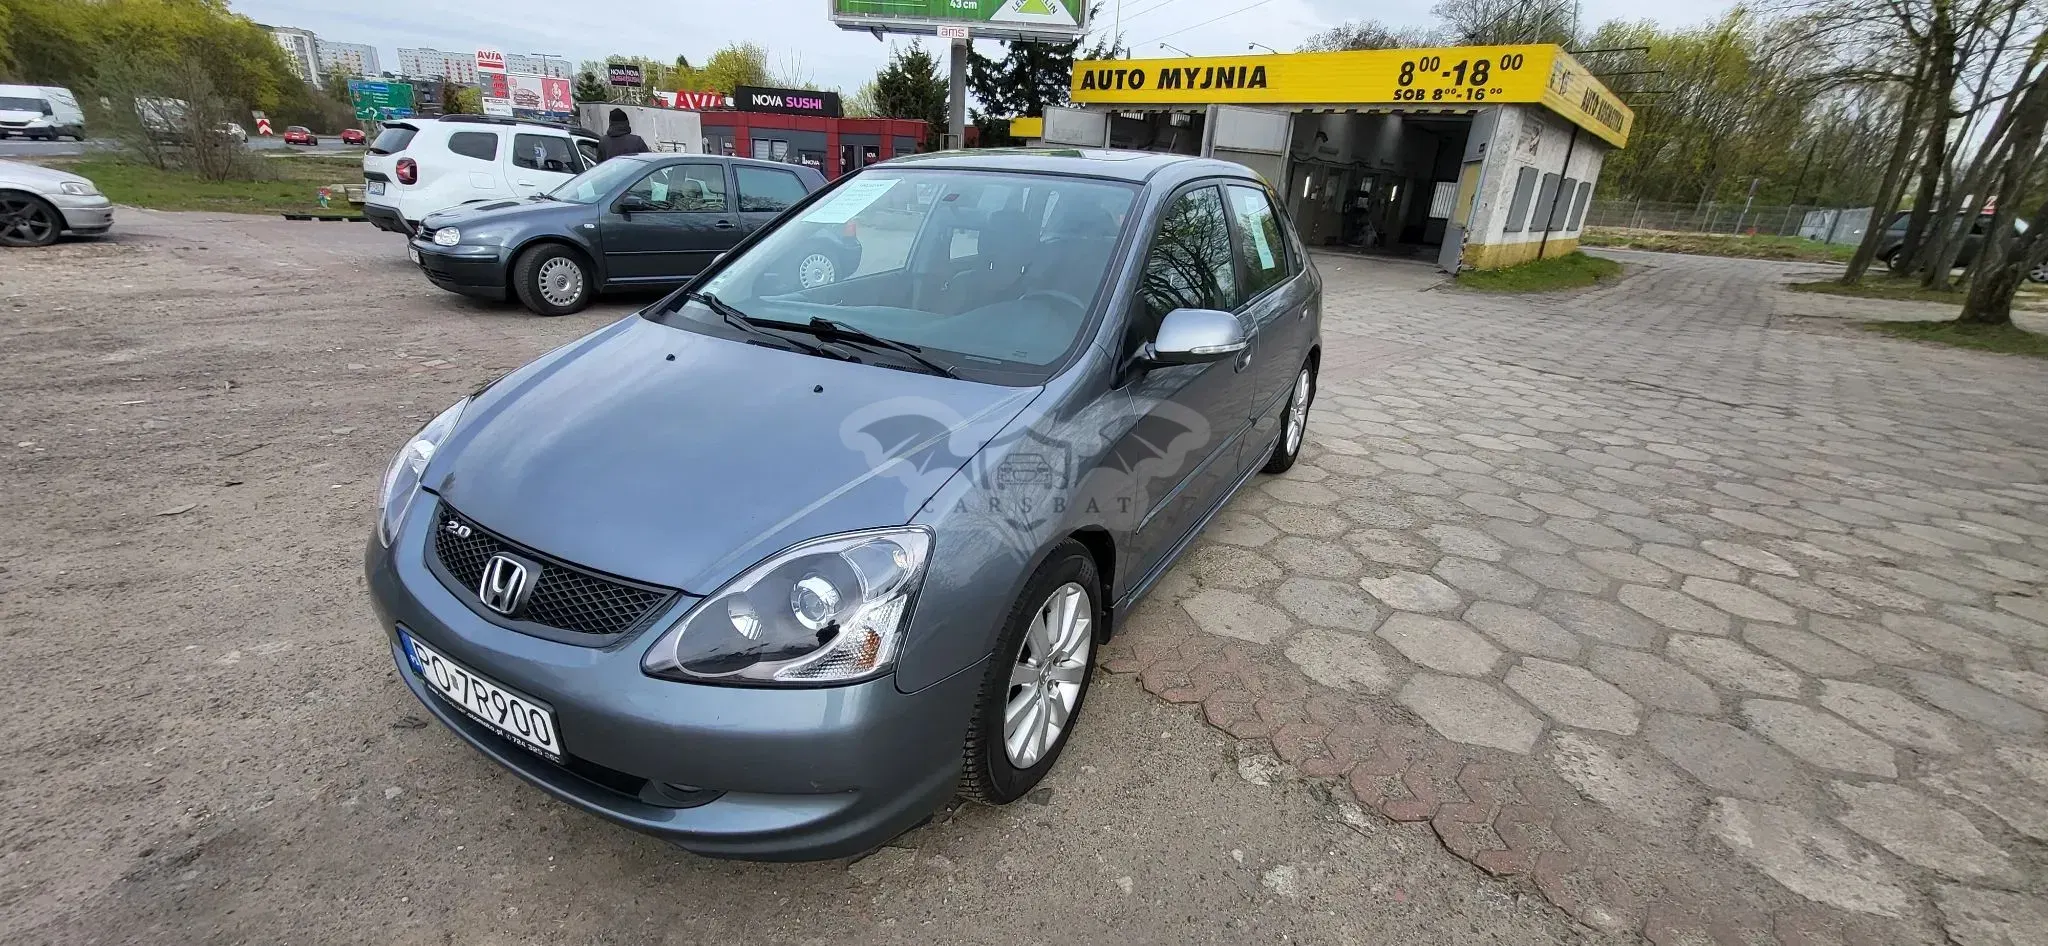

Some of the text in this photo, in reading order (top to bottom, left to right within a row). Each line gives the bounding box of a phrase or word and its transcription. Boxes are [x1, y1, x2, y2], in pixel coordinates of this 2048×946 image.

[963, 1, 978, 10] cm
[940, 28, 965, 37] ams
[477, 50, 503, 61] AVIA
[1080, 65, 1268, 89] AUTO MYJNIA
[675, 85, 724, 110] AVIA
[751, 93, 822, 110] NOVA SUSHI
[1393, 88, 1426, 100] SOB
[446, 520, 471, 538] 2.0
[412, 640, 451, 692] PO
[455, 668, 551, 746] 7R900
